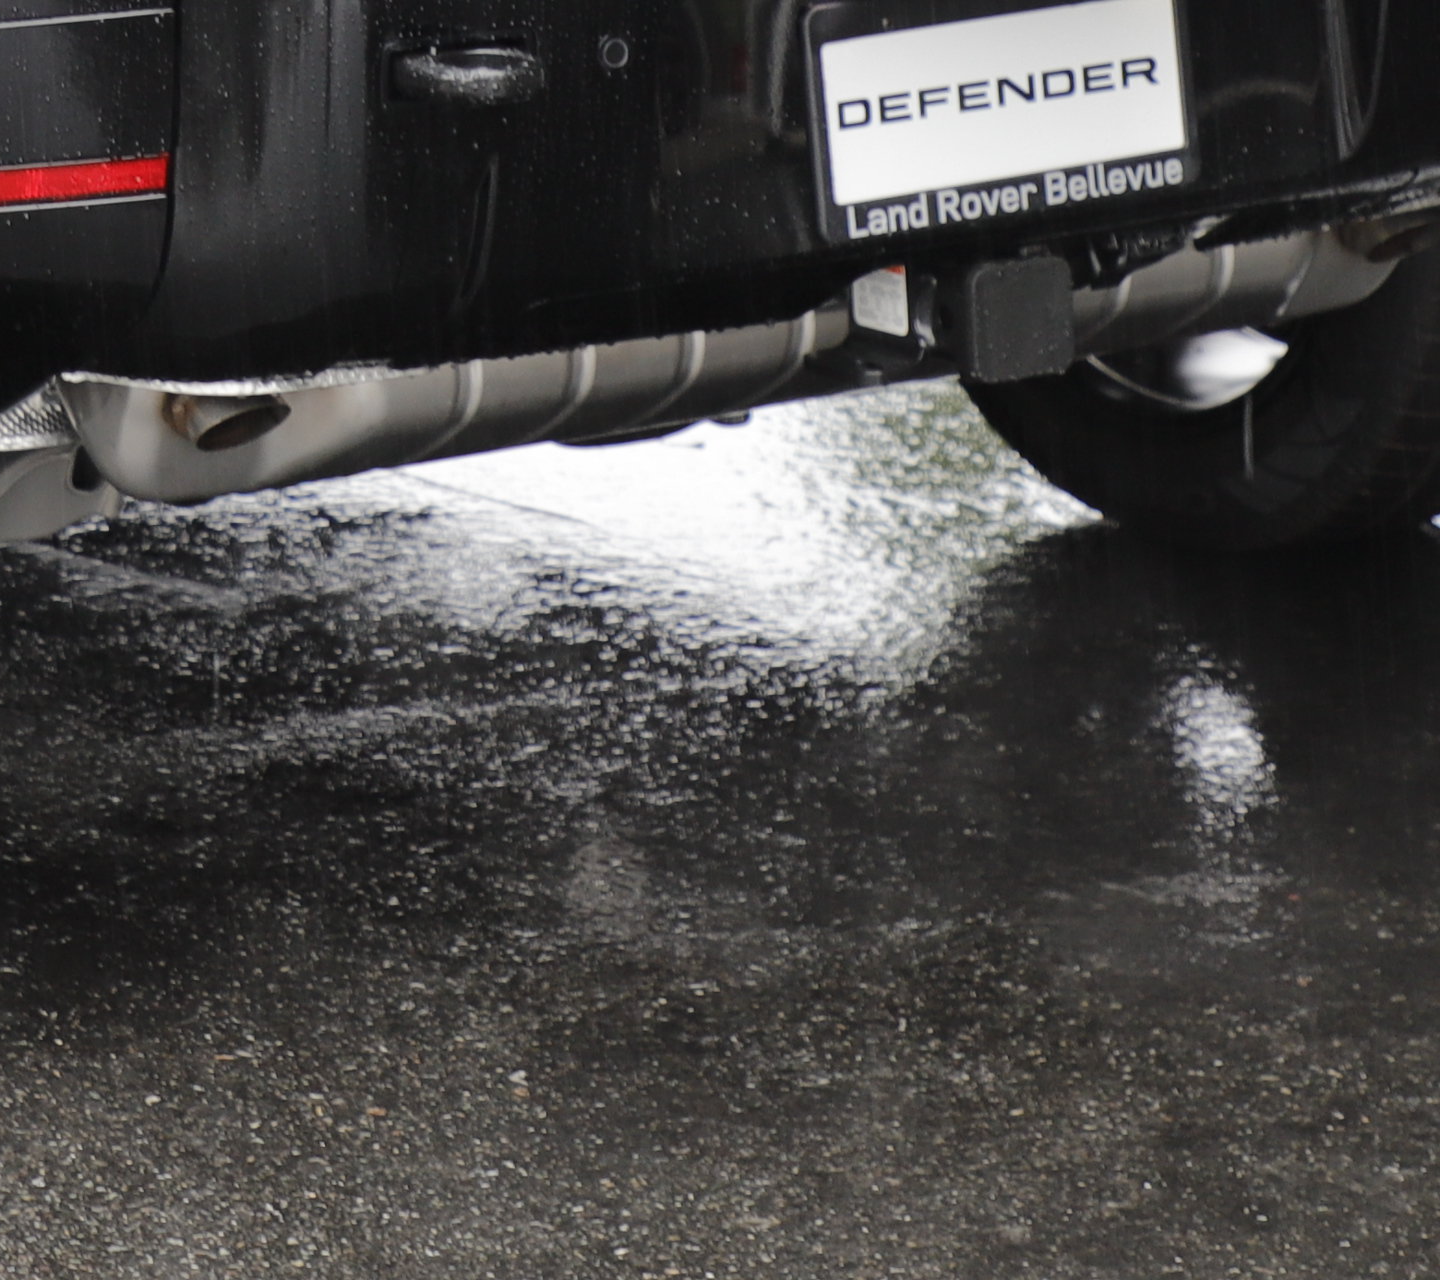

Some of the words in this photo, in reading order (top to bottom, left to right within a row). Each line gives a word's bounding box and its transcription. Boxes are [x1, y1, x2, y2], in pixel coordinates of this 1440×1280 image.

[838, 56, 1159, 131] DEFENDER
[846, 194, 930, 240] Land
[937, 180, 1037, 224] Rover
[1045, 158, 1184, 208] Bellevue
